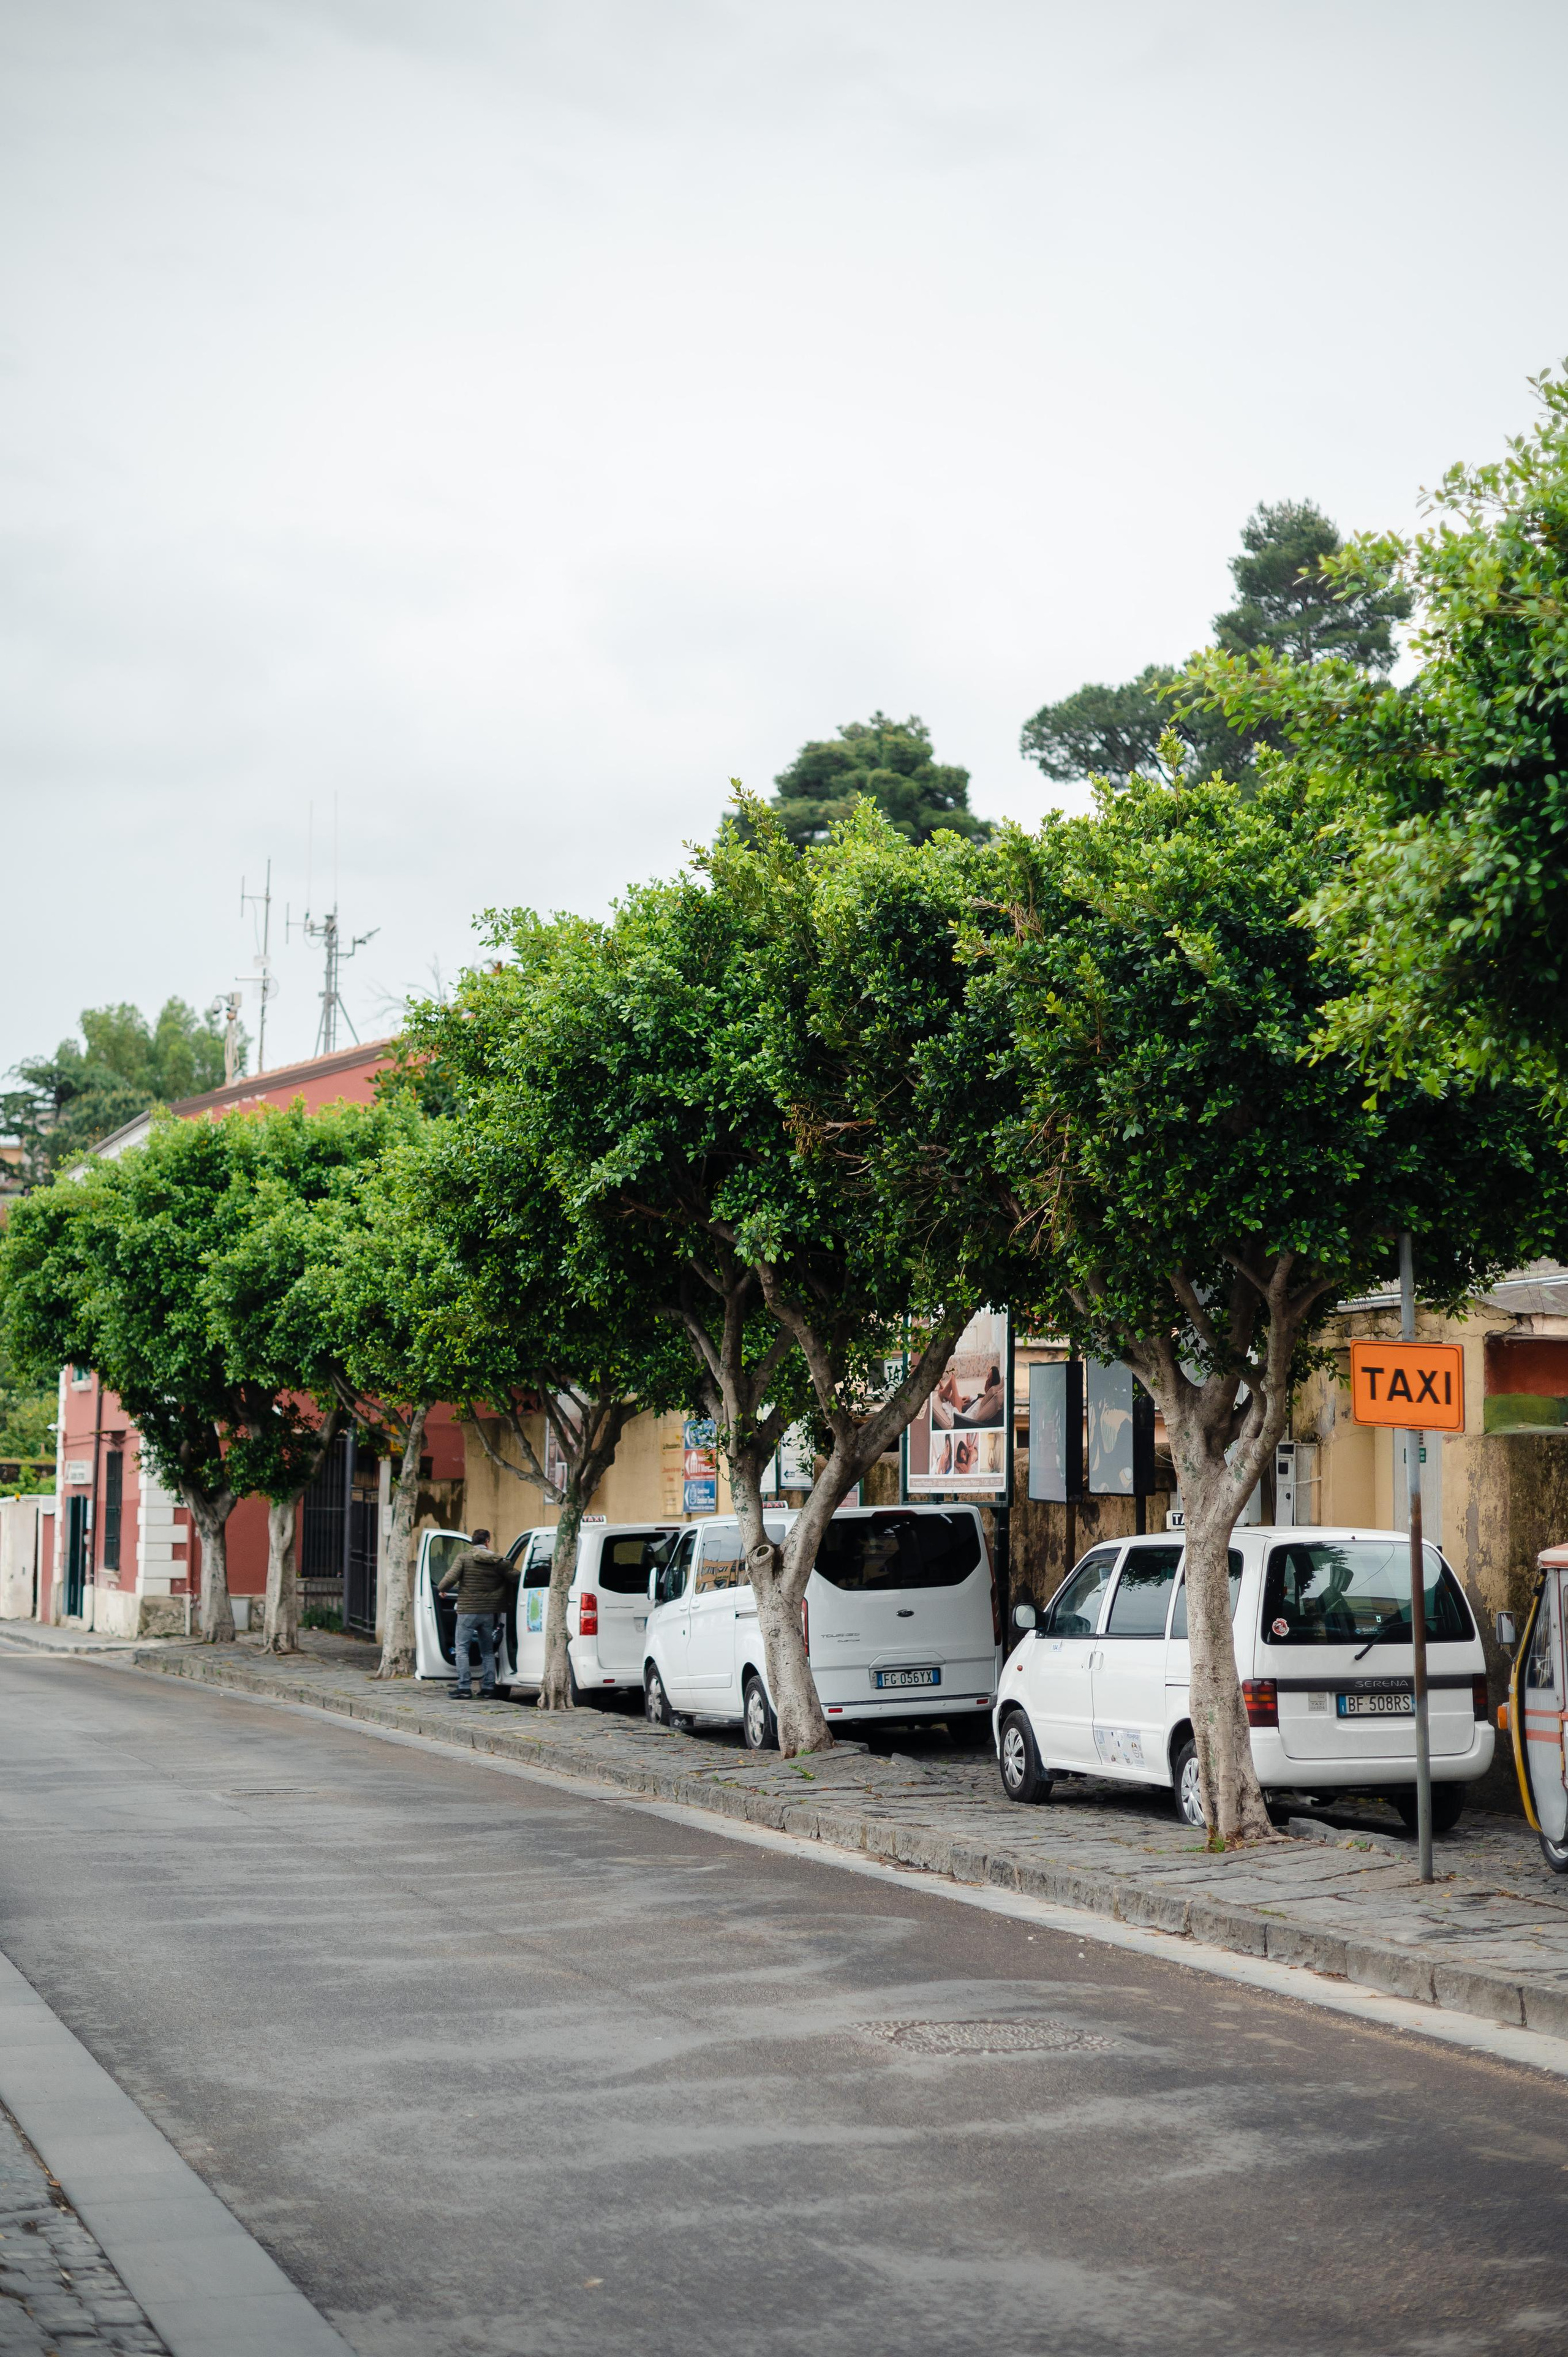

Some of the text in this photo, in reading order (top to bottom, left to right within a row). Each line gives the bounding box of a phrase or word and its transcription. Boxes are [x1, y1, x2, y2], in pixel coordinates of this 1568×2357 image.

[1361, 1366, 1452, 1405] TAXI
[884, 1674, 897, 1685] FG
[901, 1671, 933, 1684] 056YX
[1348, 1697, 1363, 1712] BF
[1370, 1695, 1410, 1711] 508RS
